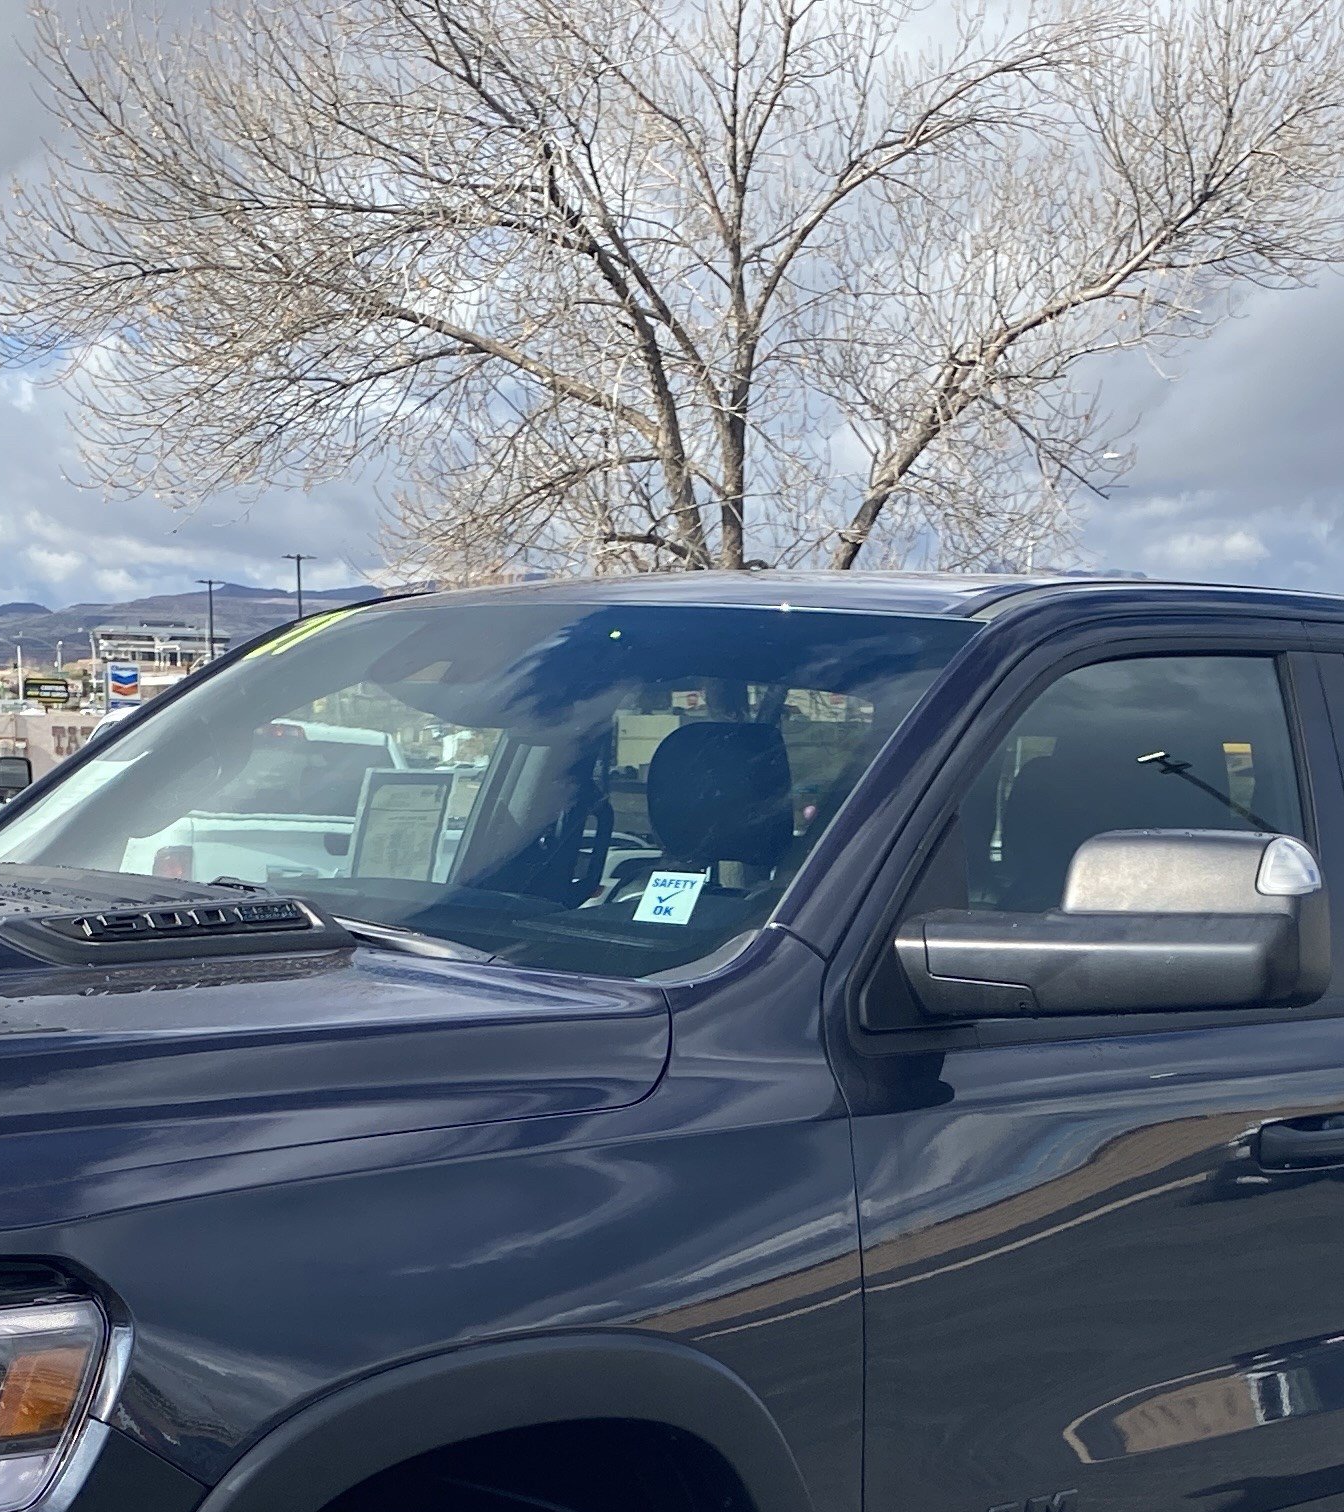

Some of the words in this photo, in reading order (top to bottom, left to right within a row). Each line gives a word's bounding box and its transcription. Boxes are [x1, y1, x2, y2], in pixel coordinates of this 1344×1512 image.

[652, 878, 697, 889] SAFETY
[653, 905, 676, 916] OK
[71, 908, 238, 937] 1500
